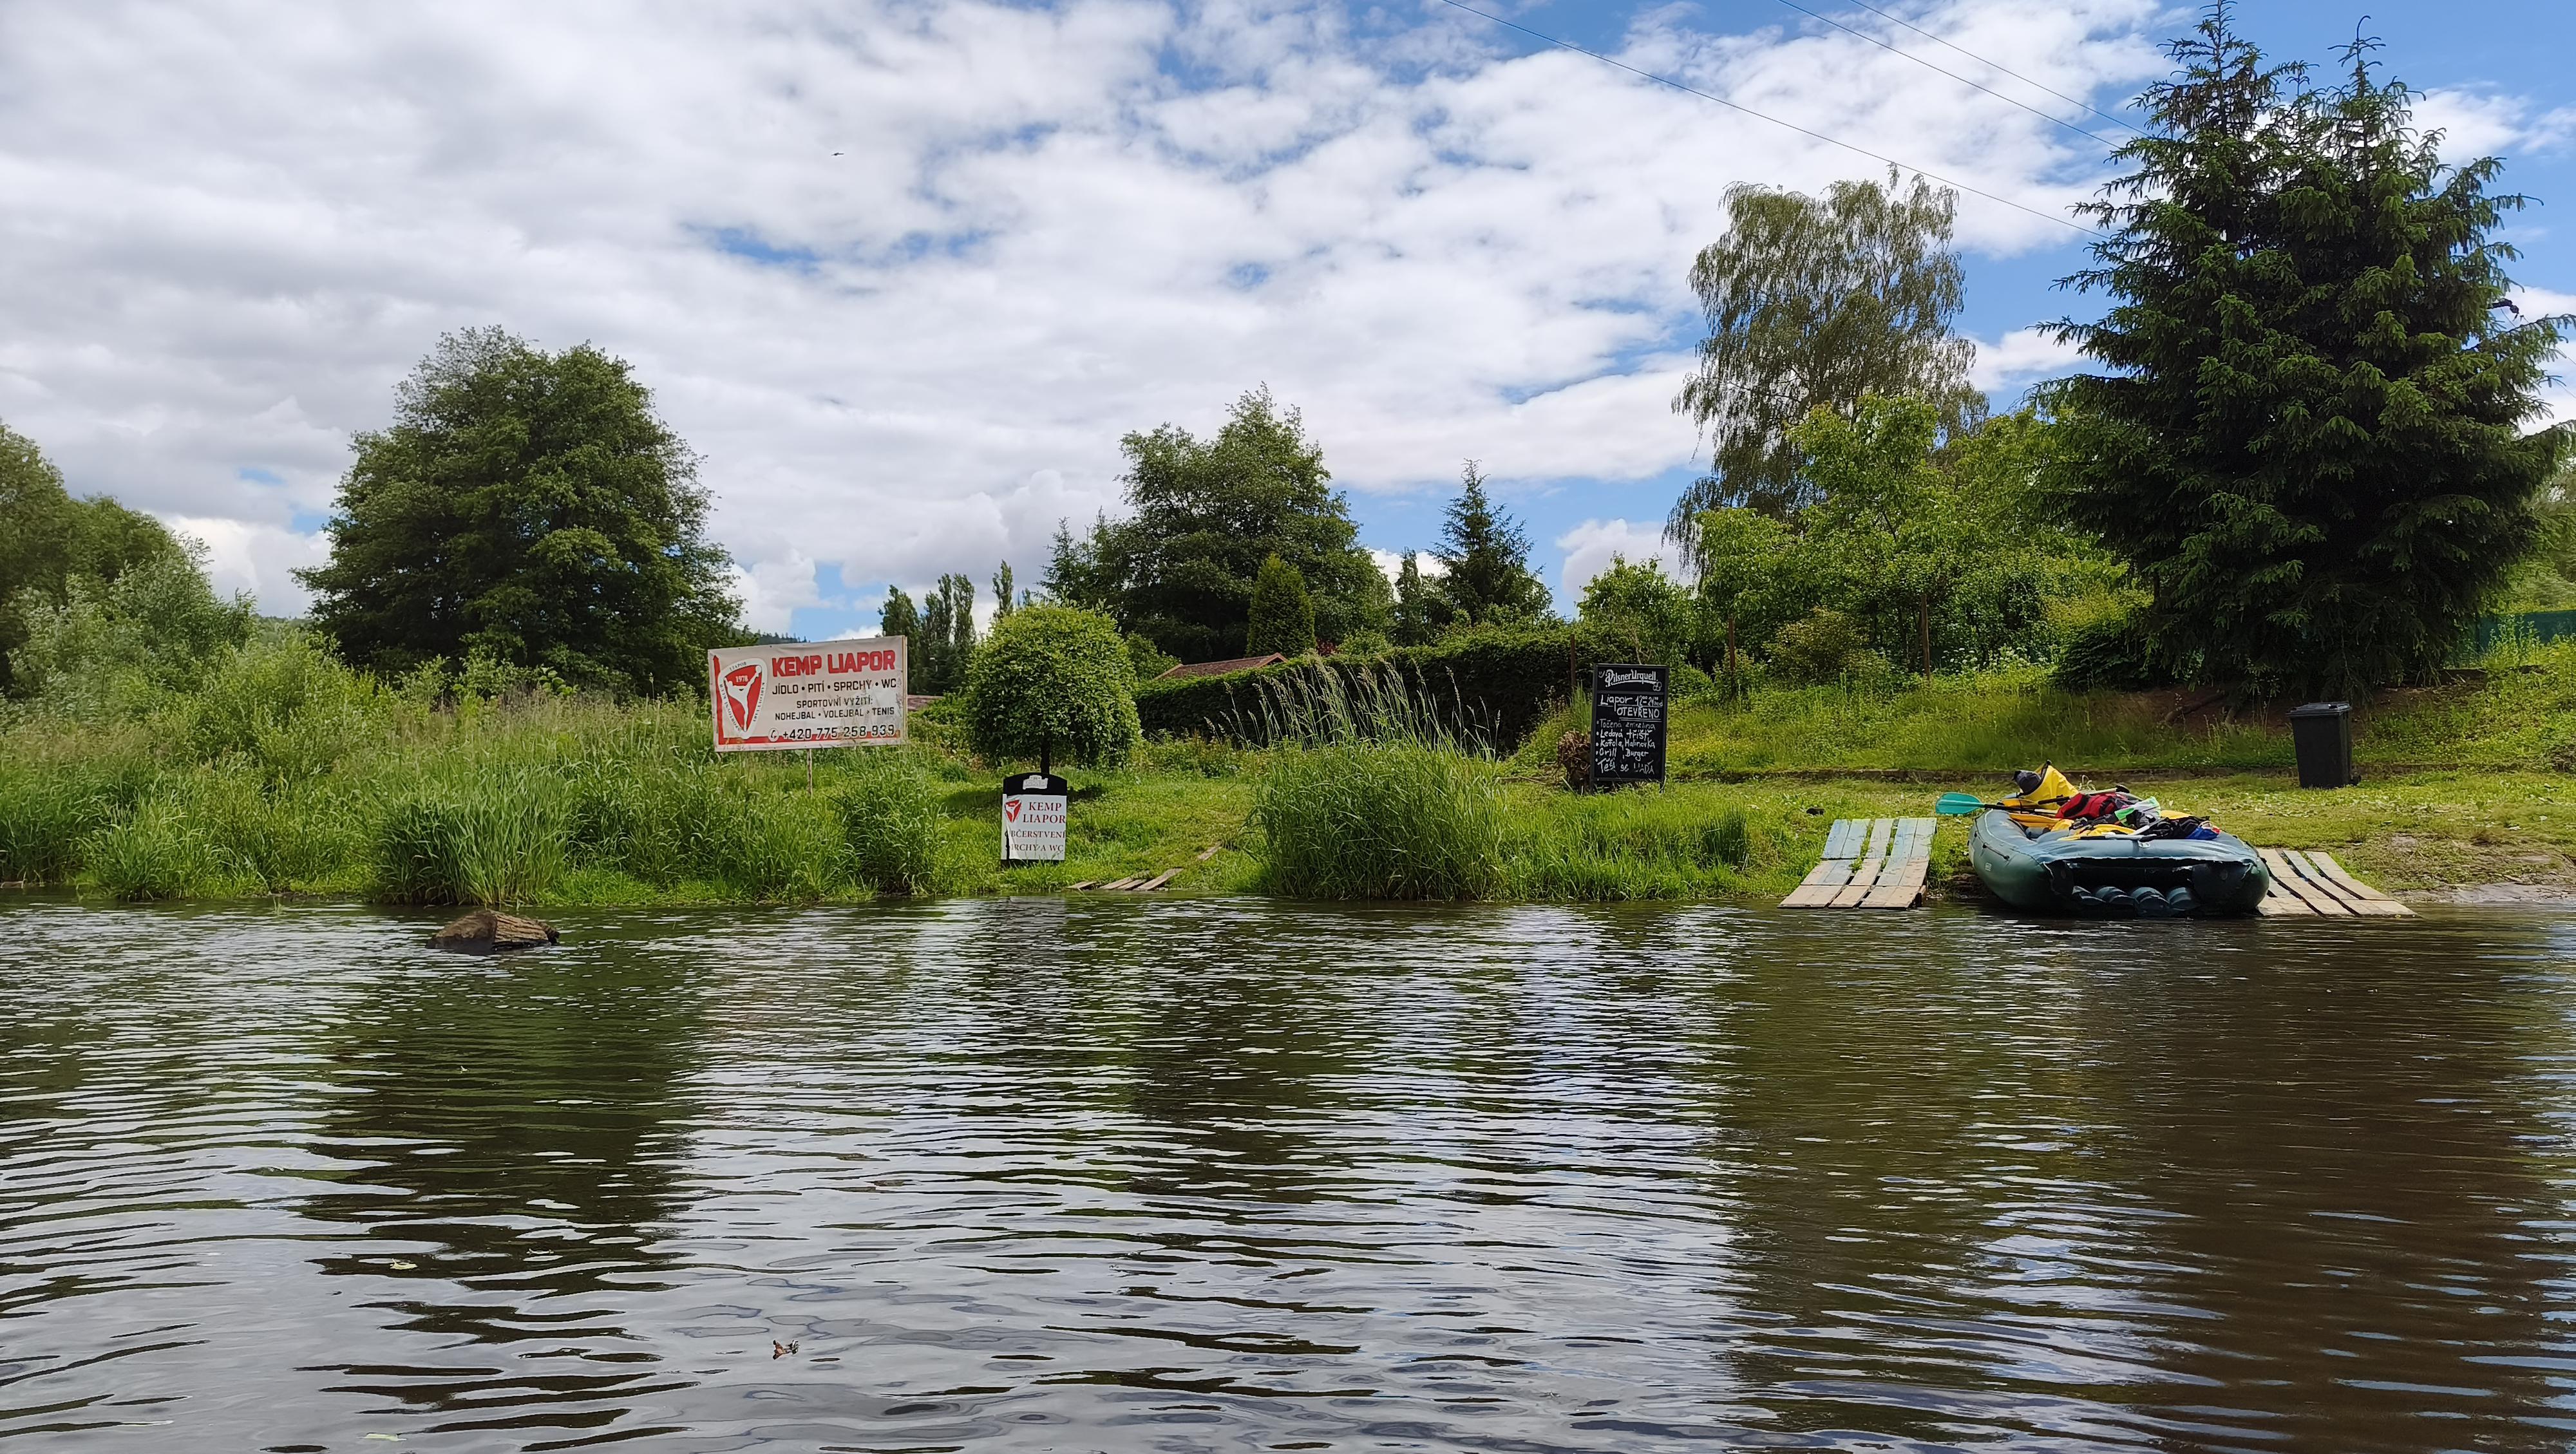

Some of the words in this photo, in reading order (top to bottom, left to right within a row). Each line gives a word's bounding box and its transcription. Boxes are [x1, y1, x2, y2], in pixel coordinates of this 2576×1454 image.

[772, 655, 822, 677] KEMP
[828, 650, 896, 674] LIAPOR
[1605, 669, 1632, 688] Pilsner
[1631, 669, 1656, 685] Urquell
[772, 683, 799, 694] JÍDLO
[808, 681, 824, 693] PITÍ
[834, 679, 872, 692] SPRCHY
[882, 678, 896, 688] WC
[797, 696, 841, 708] SPORTOVNÍ
[844, 695, 873, 706] VYŽITÍ:
[1600, 694, 1633, 712] Liapor
[775, 712, 816, 721] NOHEJBAL
[824, 709, 864, 719] VOLEJBAL
[872, 707, 895, 715] TENIS
[1616, 706, 1660, 719] OTEVŘENO
[783, 728, 811, 740] +420
[817, 728, 838, 738] 775
[844, 726, 866, 737] 258
[872, 724, 895, 736] 939
[1029, 802, 1062, 811] KEMP
[1023, 814, 1066, 824] LIAPOR
[1050, 844, 1065, 853] WC
